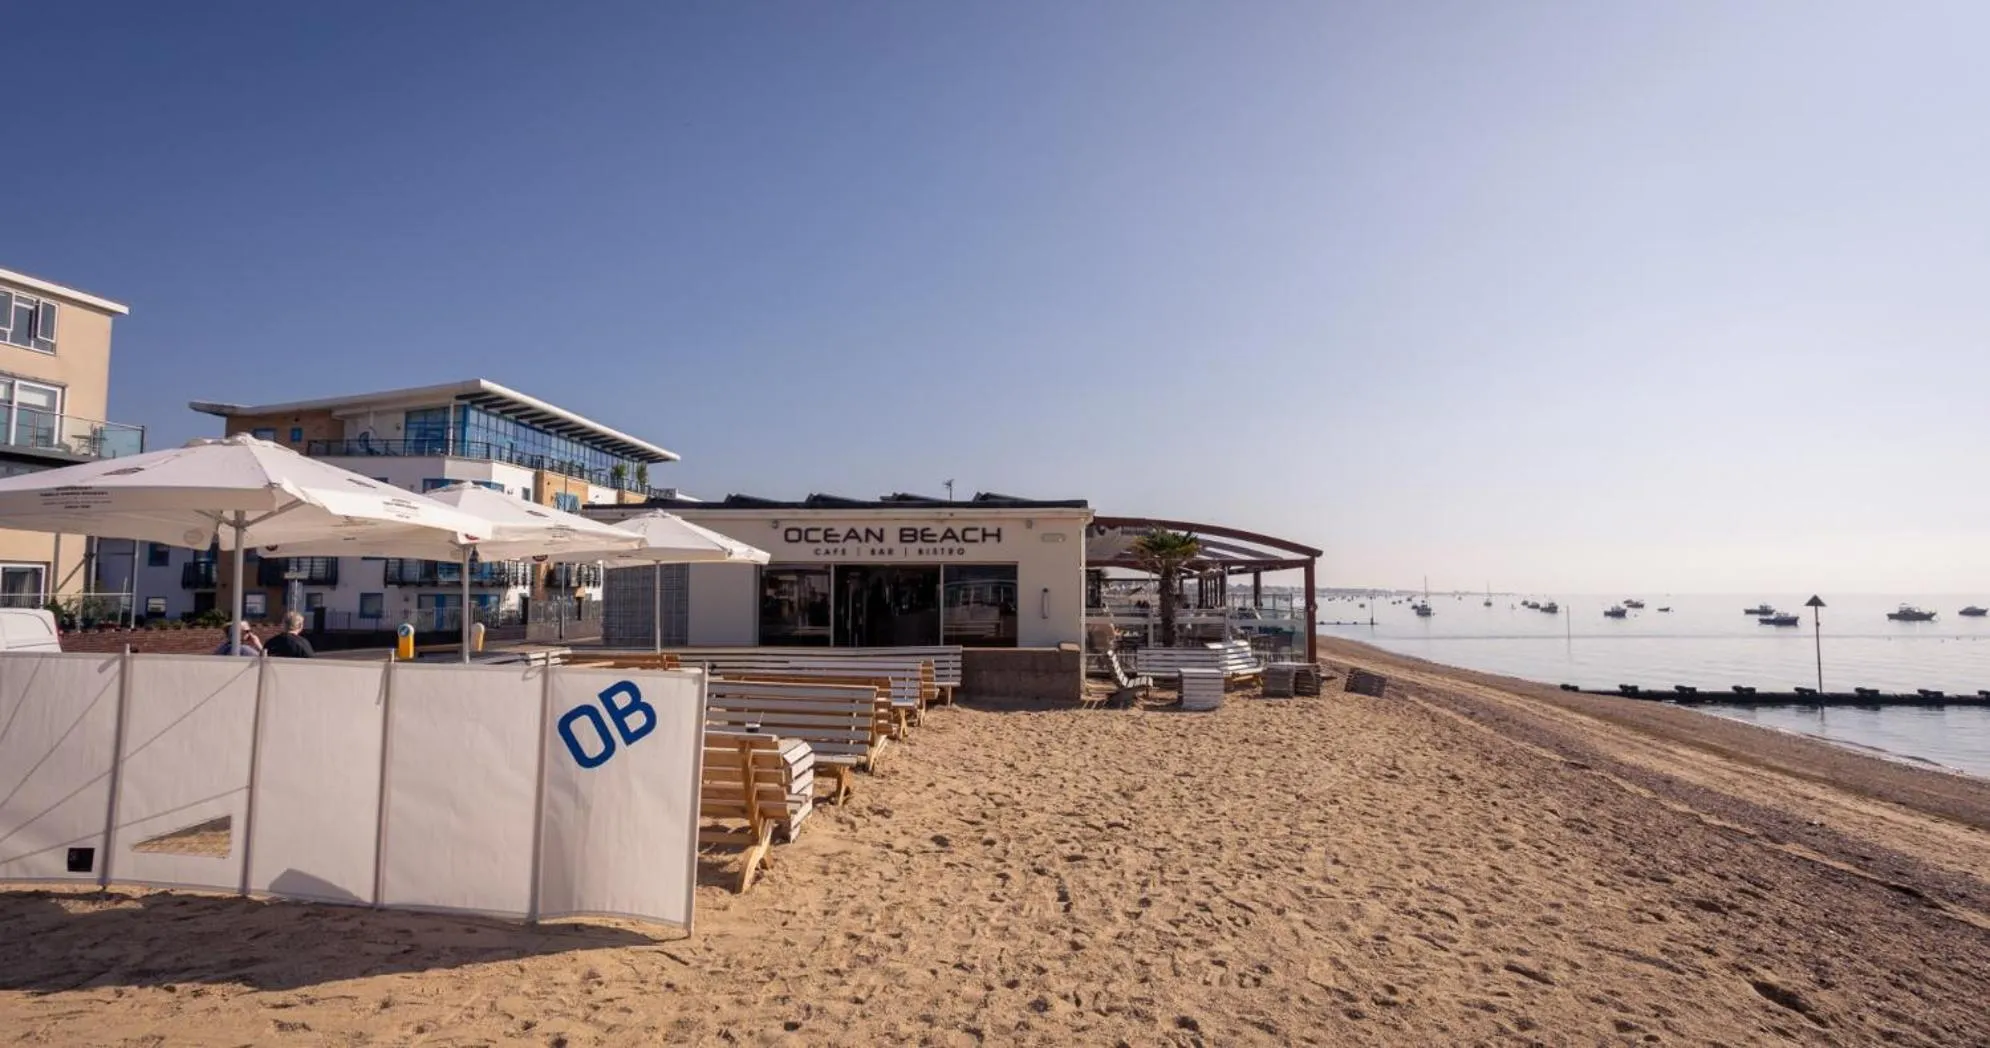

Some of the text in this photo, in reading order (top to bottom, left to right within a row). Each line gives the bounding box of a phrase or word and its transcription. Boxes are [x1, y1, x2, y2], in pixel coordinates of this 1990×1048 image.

[784, 527, 1002, 544] OCEAN BEACH
[813, 547, 966, 557] CAFE BAR BISTRO
[557, 680, 658, 769] OB
